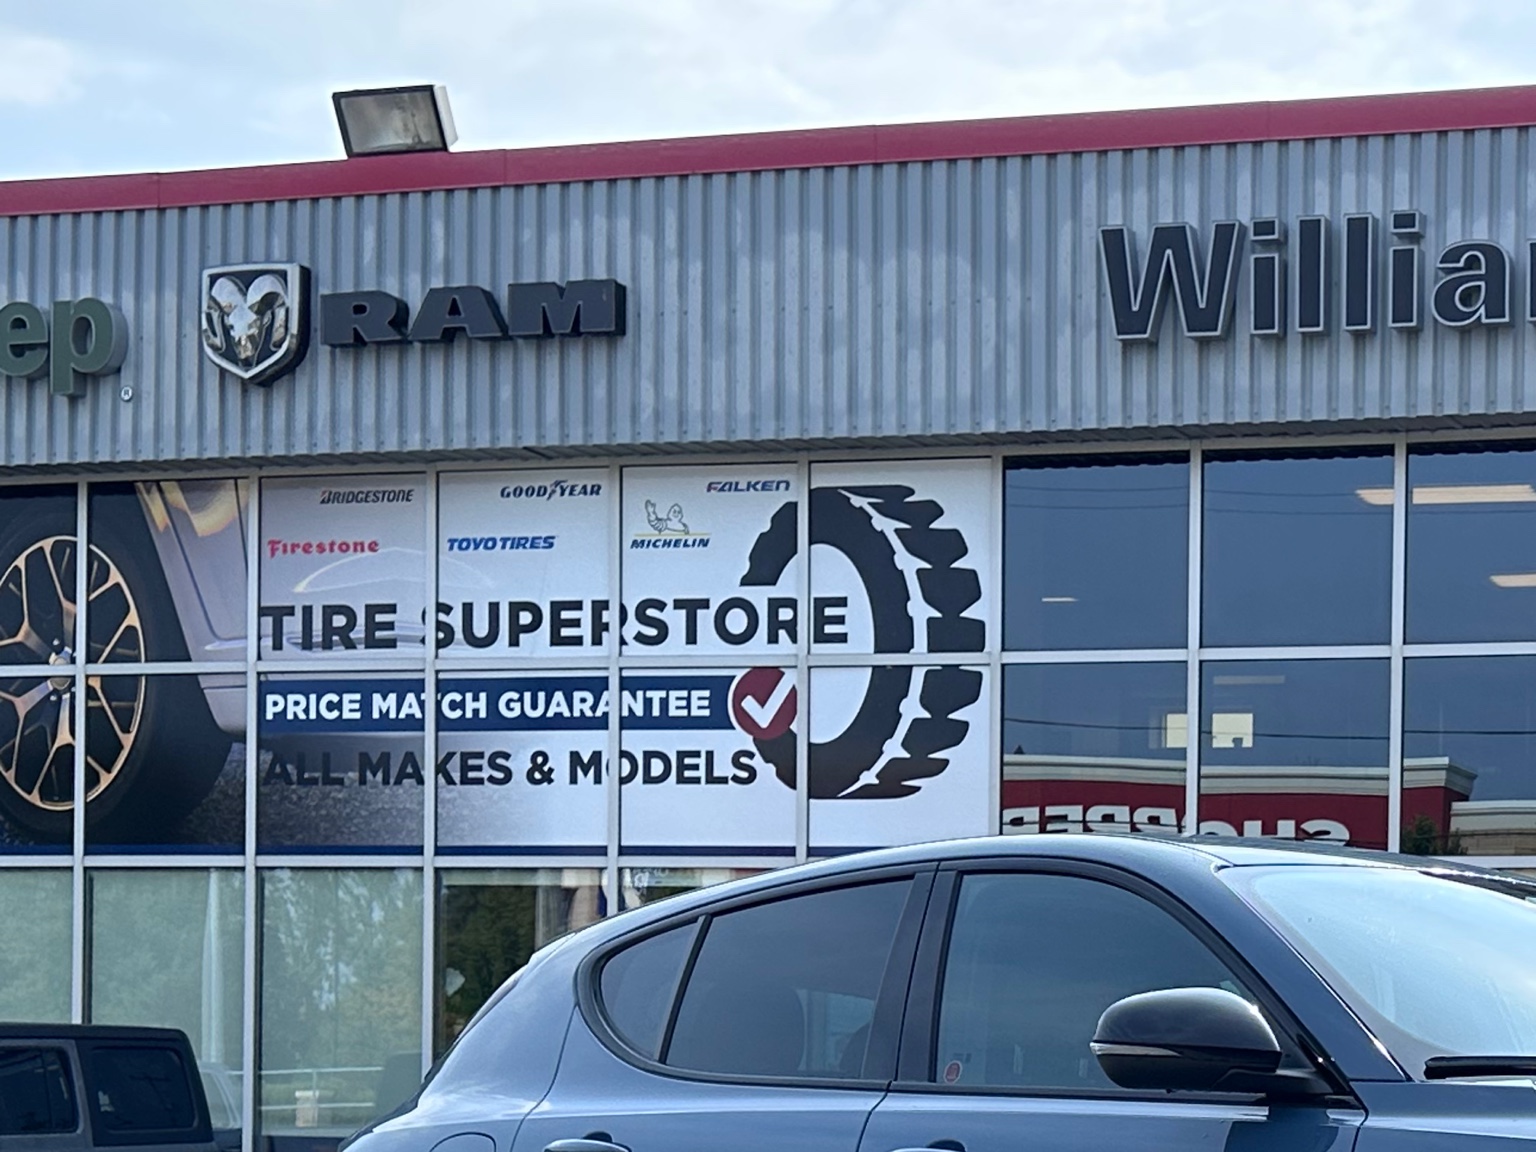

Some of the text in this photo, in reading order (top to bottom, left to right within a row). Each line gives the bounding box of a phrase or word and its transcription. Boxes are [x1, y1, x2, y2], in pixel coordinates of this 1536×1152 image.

[320, 279, 626, 347] RAM
[319, 489, 415, 504] BRIDGESTONE
[706, 480, 790, 493] FALKEN
[267, 539, 379, 558] Firestone
[630, 537, 710, 549] MICHELIN
[259, 596, 848, 651] TIRE SUPERSTORE
[265, 693, 361, 720] PRICE
[498, 689, 711, 718] GUARANTEE
[262, 749, 758, 786] ALL MAKES & MODELS
